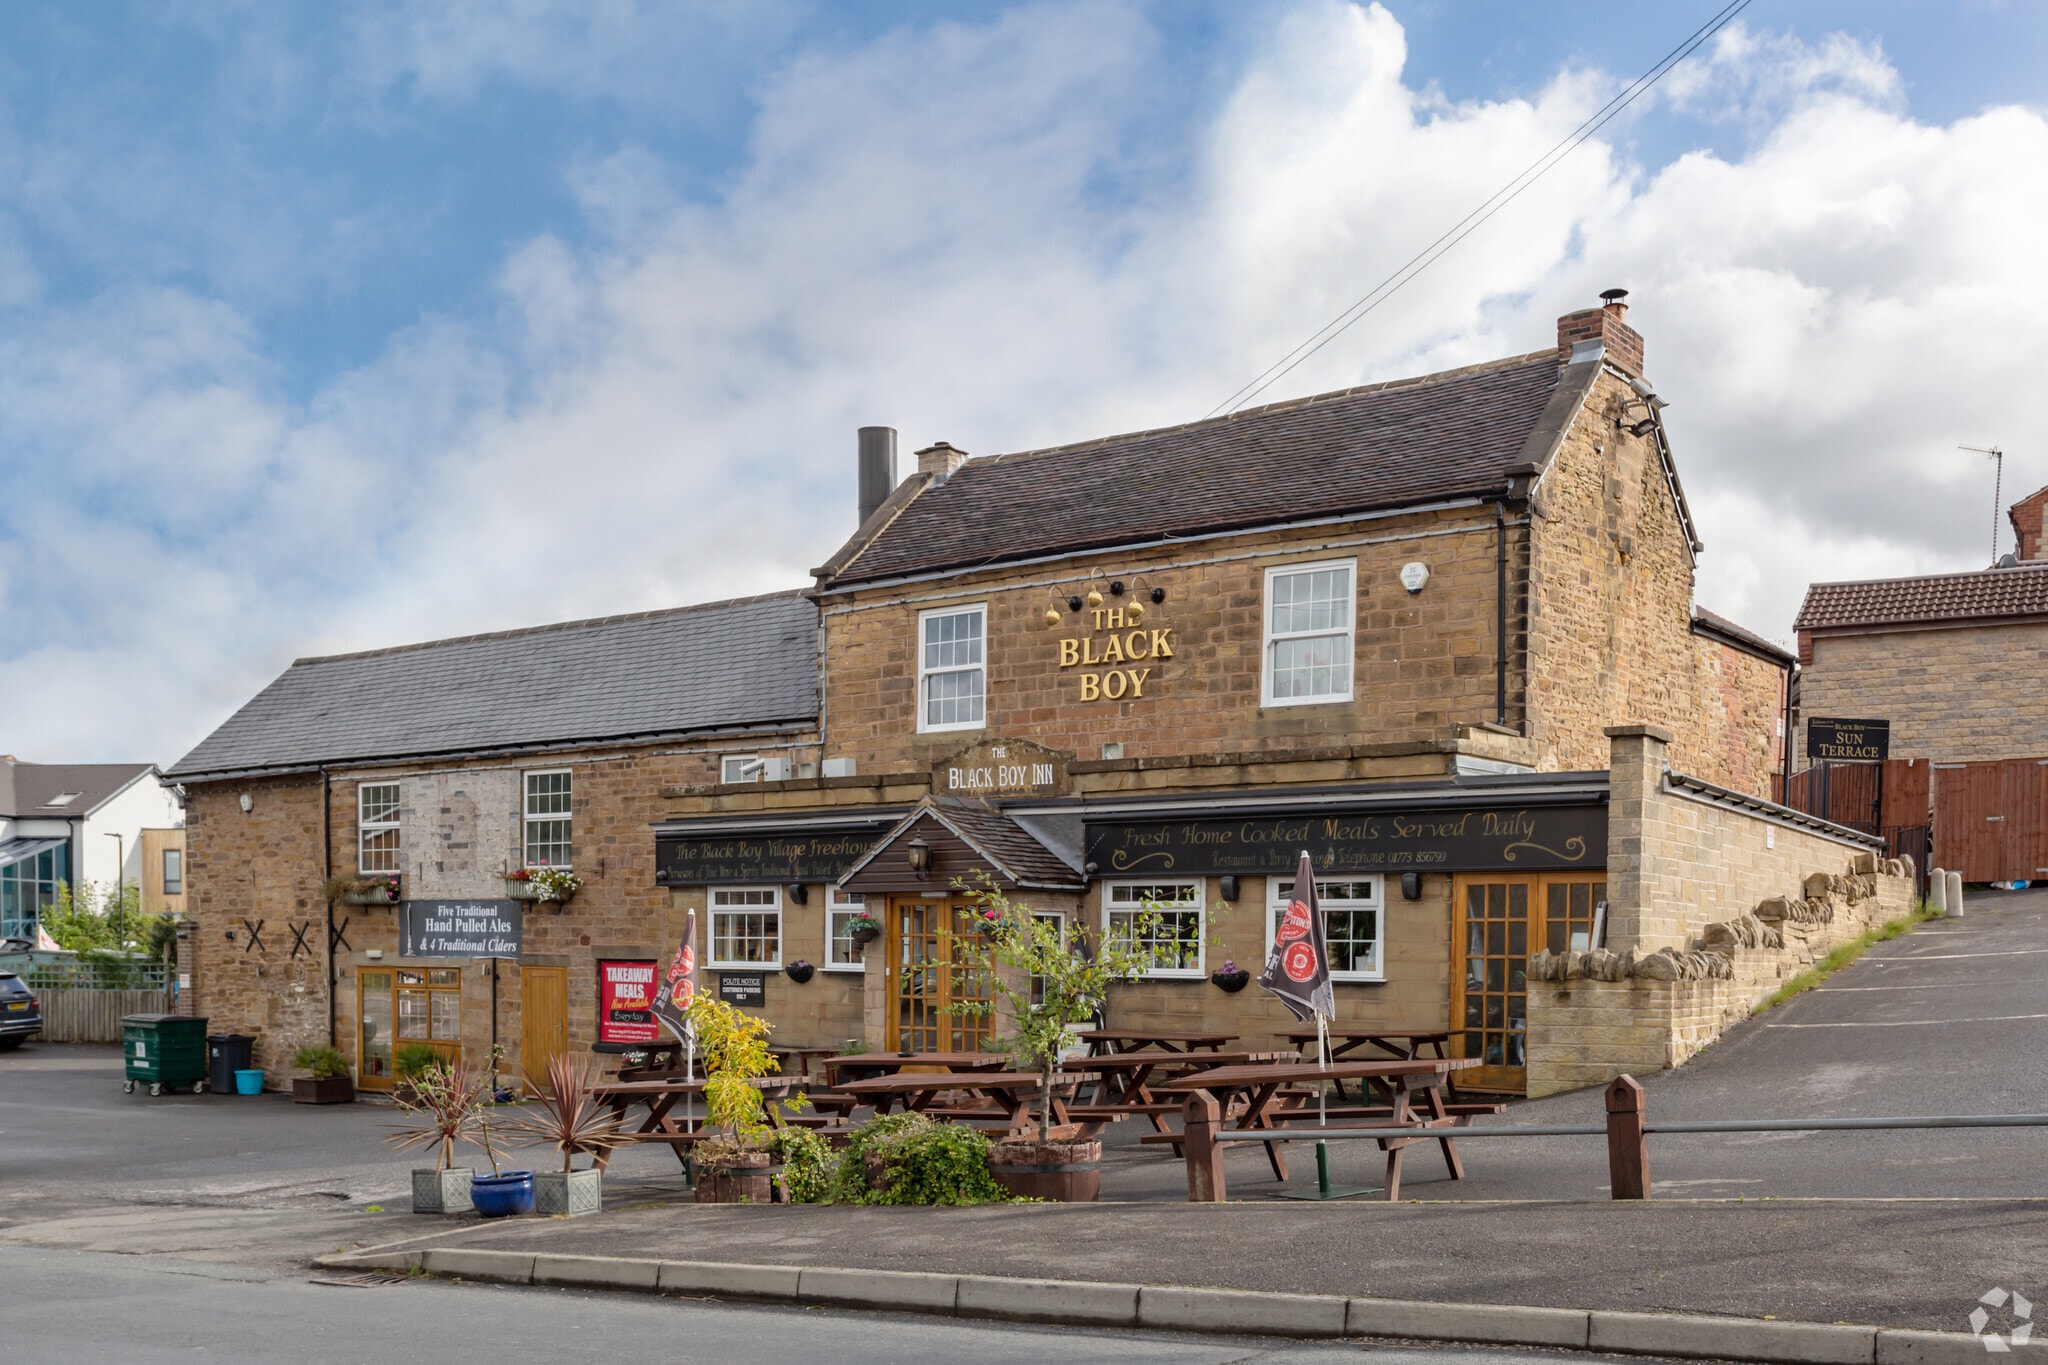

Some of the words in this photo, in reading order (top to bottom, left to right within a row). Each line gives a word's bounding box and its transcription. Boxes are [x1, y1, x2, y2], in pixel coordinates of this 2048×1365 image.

[1059, 628, 1174, 667] BLACK
[1080, 668, 1151, 702] BOY
[992, 747, 1006, 758] THE
[949, 767, 994, 789] BLACK
[998, 765, 1027, 786] BOY
[1032, 763, 1054, 785] INN
[1123, 826, 1170, 848] Fresh
[1180, 823, 1233, 846] Home
[1240, 820, 1315, 844] Cooked
[1321, 816, 1379, 840] Meals
[1390, 815, 1472, 839] Served
[1482, 811, 1536, 842] Daily
[676, 841, 698, 860] The
[701, 838, 735, 858] Black
[737, 838, 762, 862] Boy
[767, 837, 806, 862] Village
[808, 836, 877, 857] Freehous
[1338, 847, 1385, 868] Telephone
[1387, 851, 1412, 863] 01773
[1415, 850, 1447, 863] 856799
[438, 905, 454, 917] Five
[455, 905, 498, 917] Traditional
[425, 918, 452, 932] Hand
[455, 918, 487, 932] Pulled
[489, 918, 512, 932] Ales
[420, 937, 427, 951] &
[430, 938, 435, 950] 4
[438, 938, 486, 952] Traditional
[488, 938, 517, 952] Ciders
[606, 967, 653, 983] TAKEAWAY
[615, 983, 645, 999] MEALS
[614, 1010, 644, 1022] Everyday
